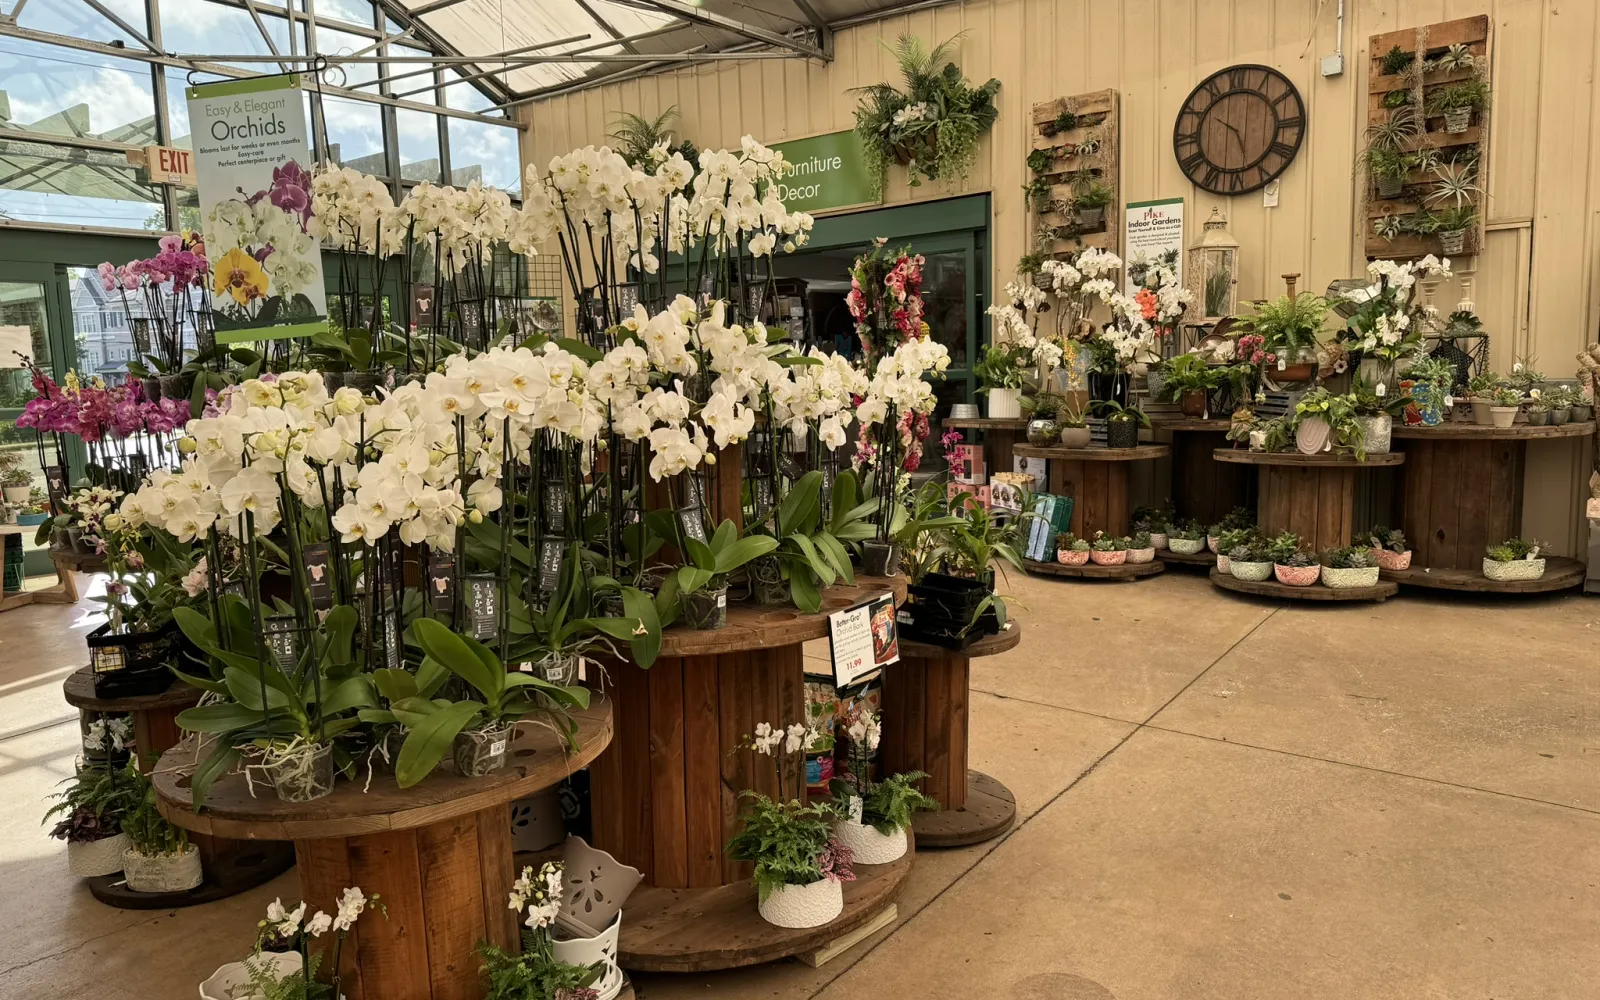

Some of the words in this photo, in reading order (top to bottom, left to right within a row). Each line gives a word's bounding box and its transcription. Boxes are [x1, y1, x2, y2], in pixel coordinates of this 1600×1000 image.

[205, 104, 231, 118] Easy
[233, 101, 242, 114] &
[244, 98, 286, 114] Elegant
[211, 112, 286, 140] Orchids
[280, 137, 300, 145] months
[159, 149, 188, 174] EXIT
[238, 150, 264, 158] Easy-care
[238, 157, 268, 166] centerpiece
[276, 154, 286, 162] gift
[782, 156, 842, 177] urniture
[778, 184, 820, 202] Decor
[1128, 220, 1150, 228] Indoor
[1152, 217, 1181, 226] Gardens
[847, 658, 861, 670] 11.99
